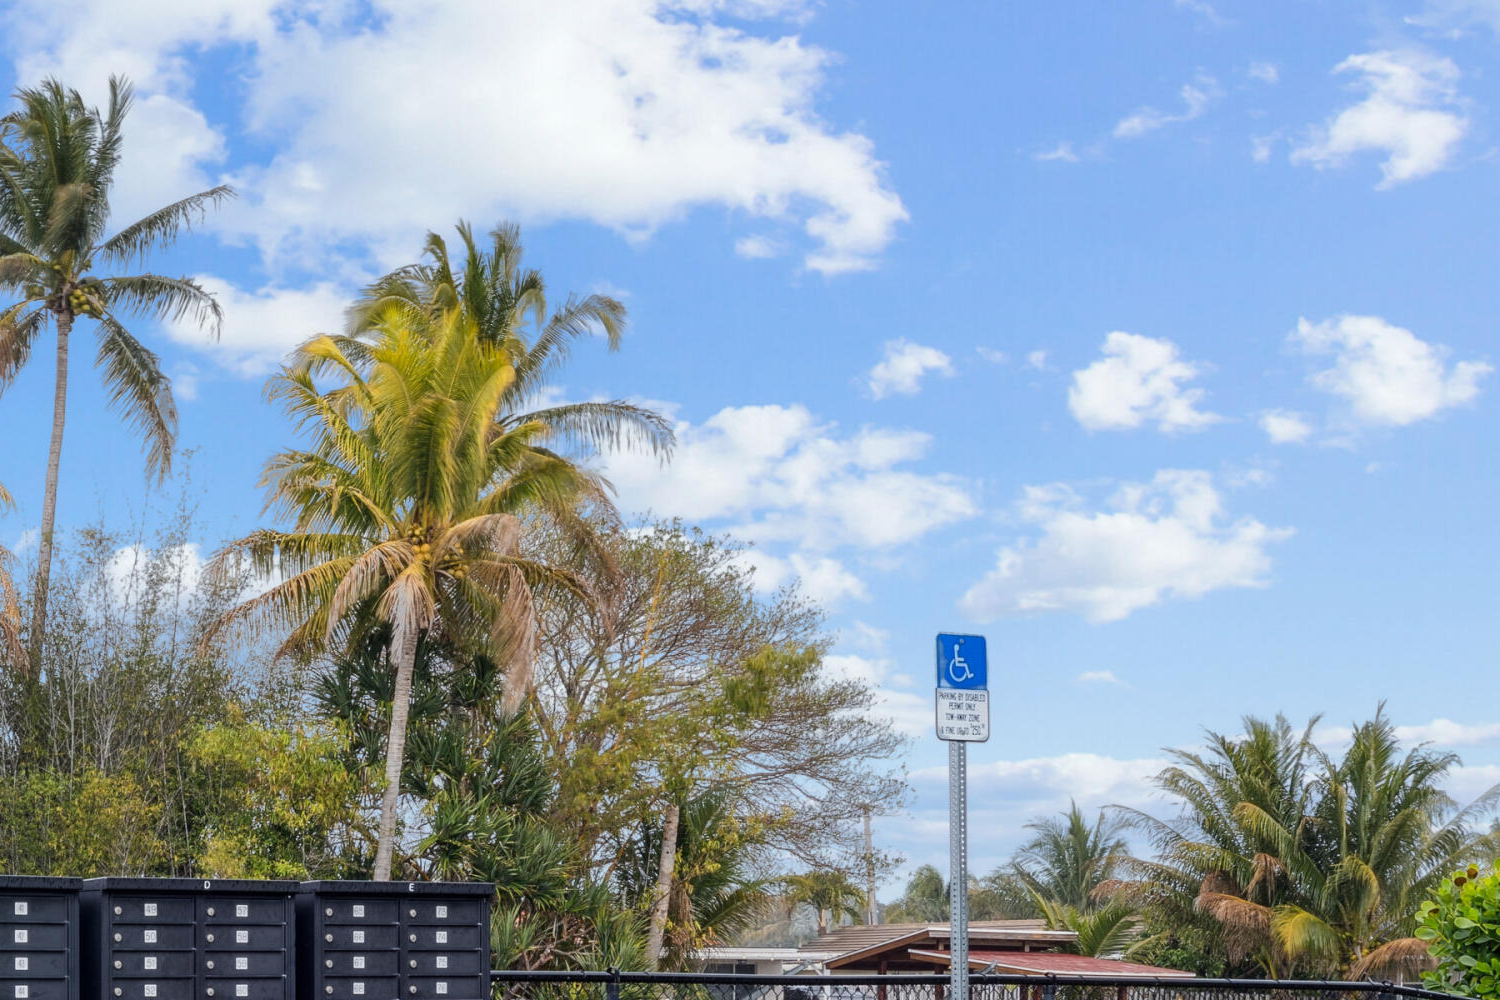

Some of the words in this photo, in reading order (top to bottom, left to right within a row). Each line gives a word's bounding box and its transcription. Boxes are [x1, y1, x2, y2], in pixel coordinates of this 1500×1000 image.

[968, 714, 980, 722] ZONE
[204, 880, 211, 889] D
[408, 883, 415, 892] E
